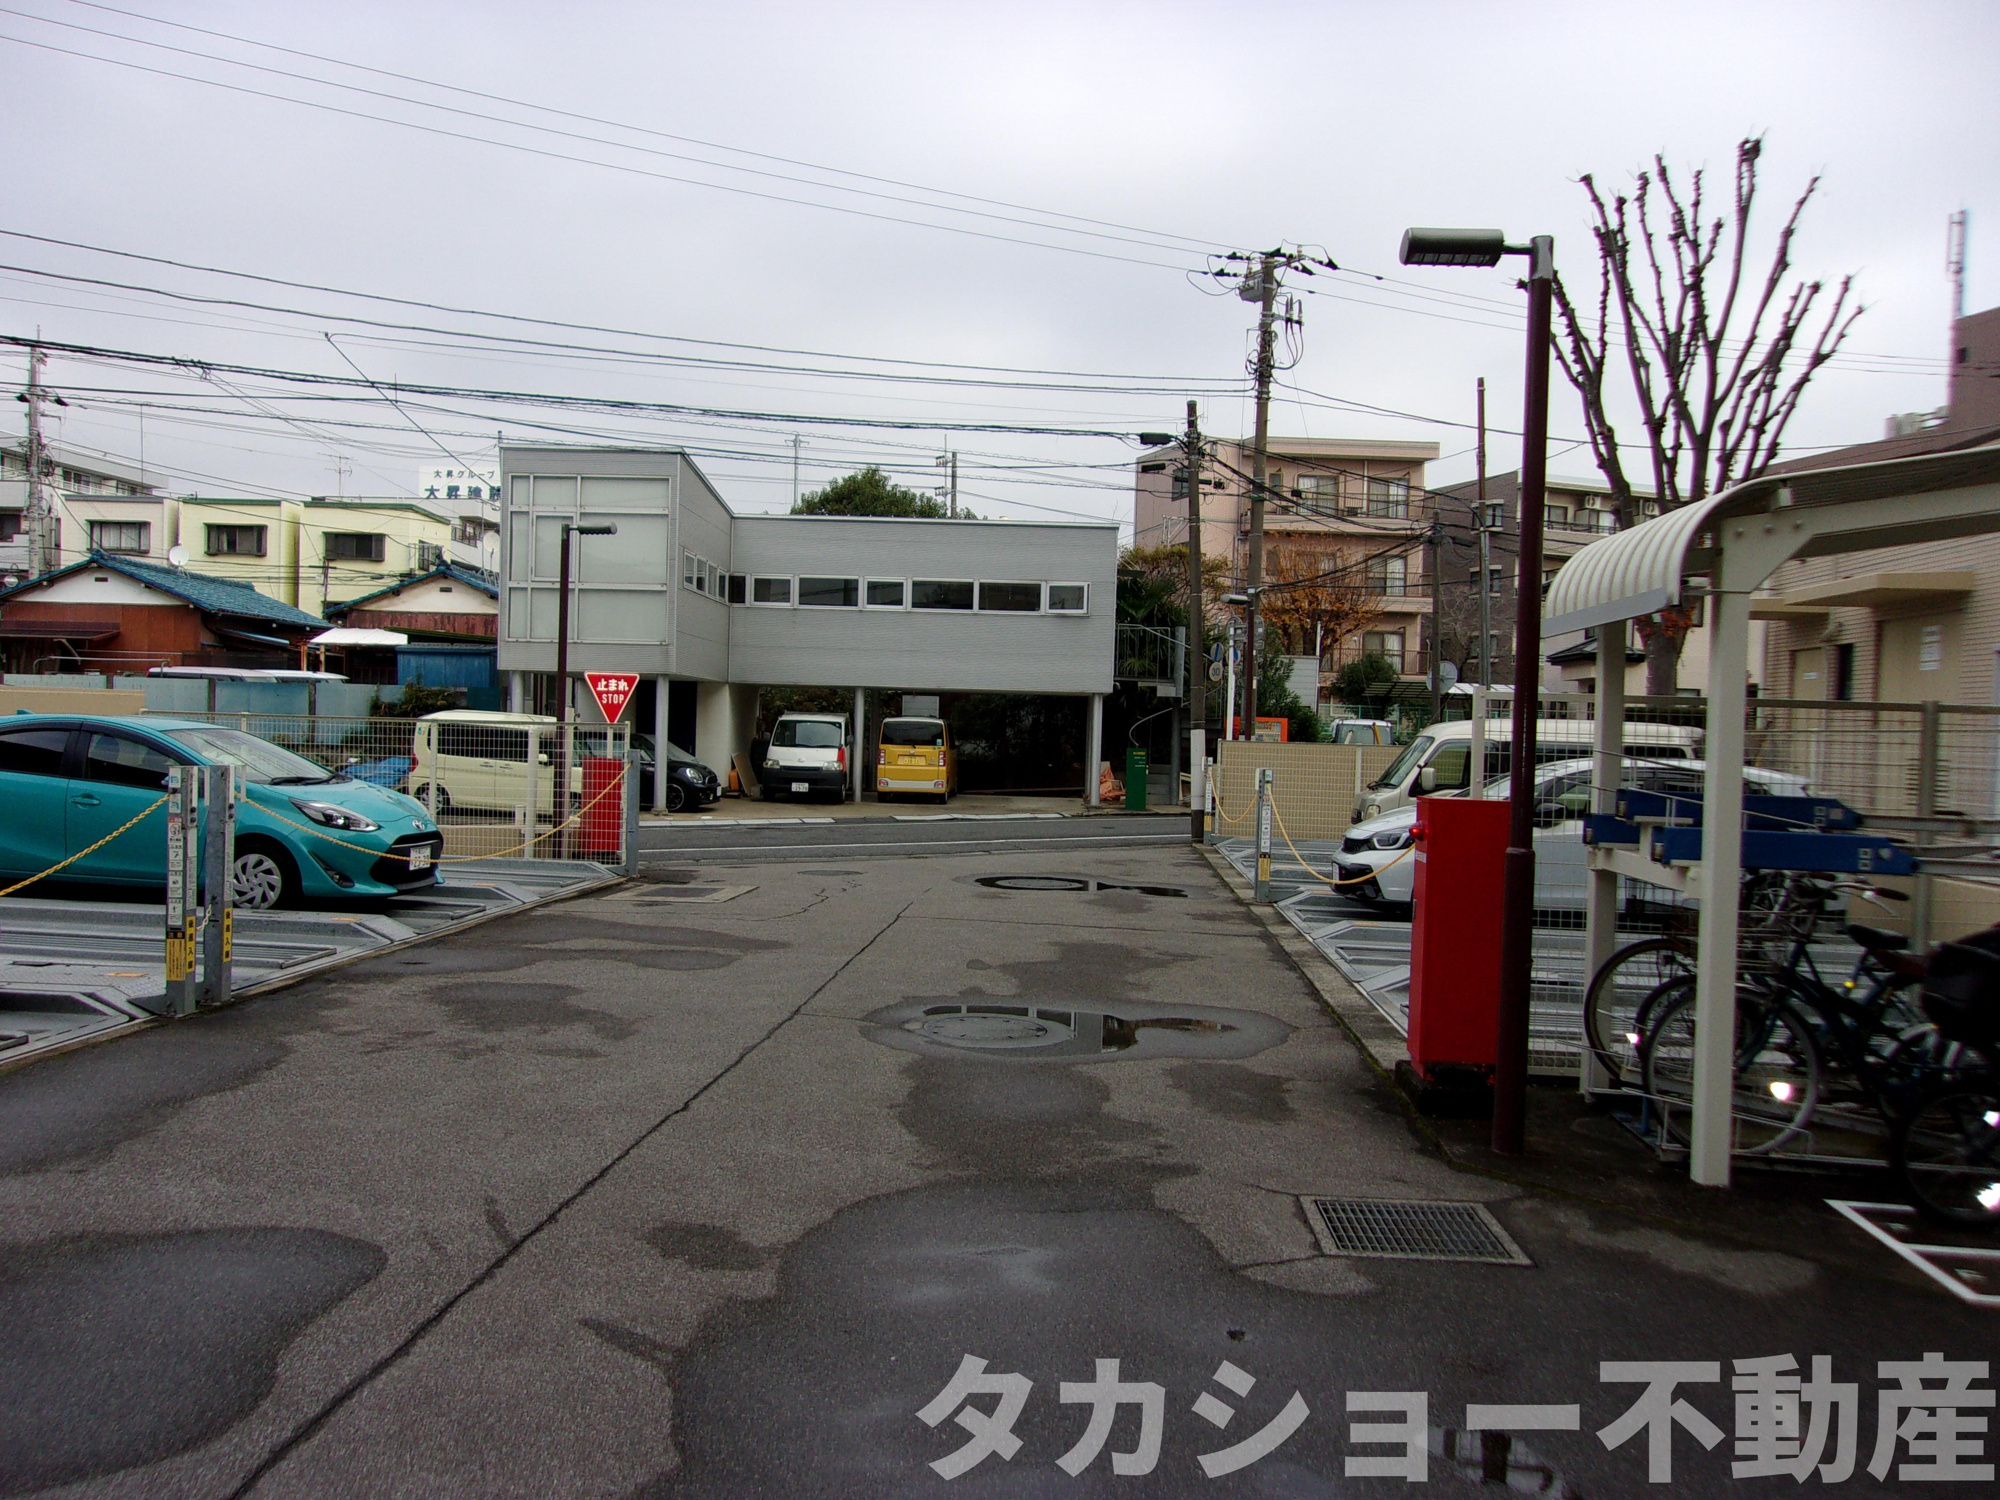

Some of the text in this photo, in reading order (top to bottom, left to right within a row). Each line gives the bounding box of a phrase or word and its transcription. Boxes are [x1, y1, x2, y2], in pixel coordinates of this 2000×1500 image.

[596, 678, 629, 691] 止まれ
[602, 693, 624, 704] STOP
